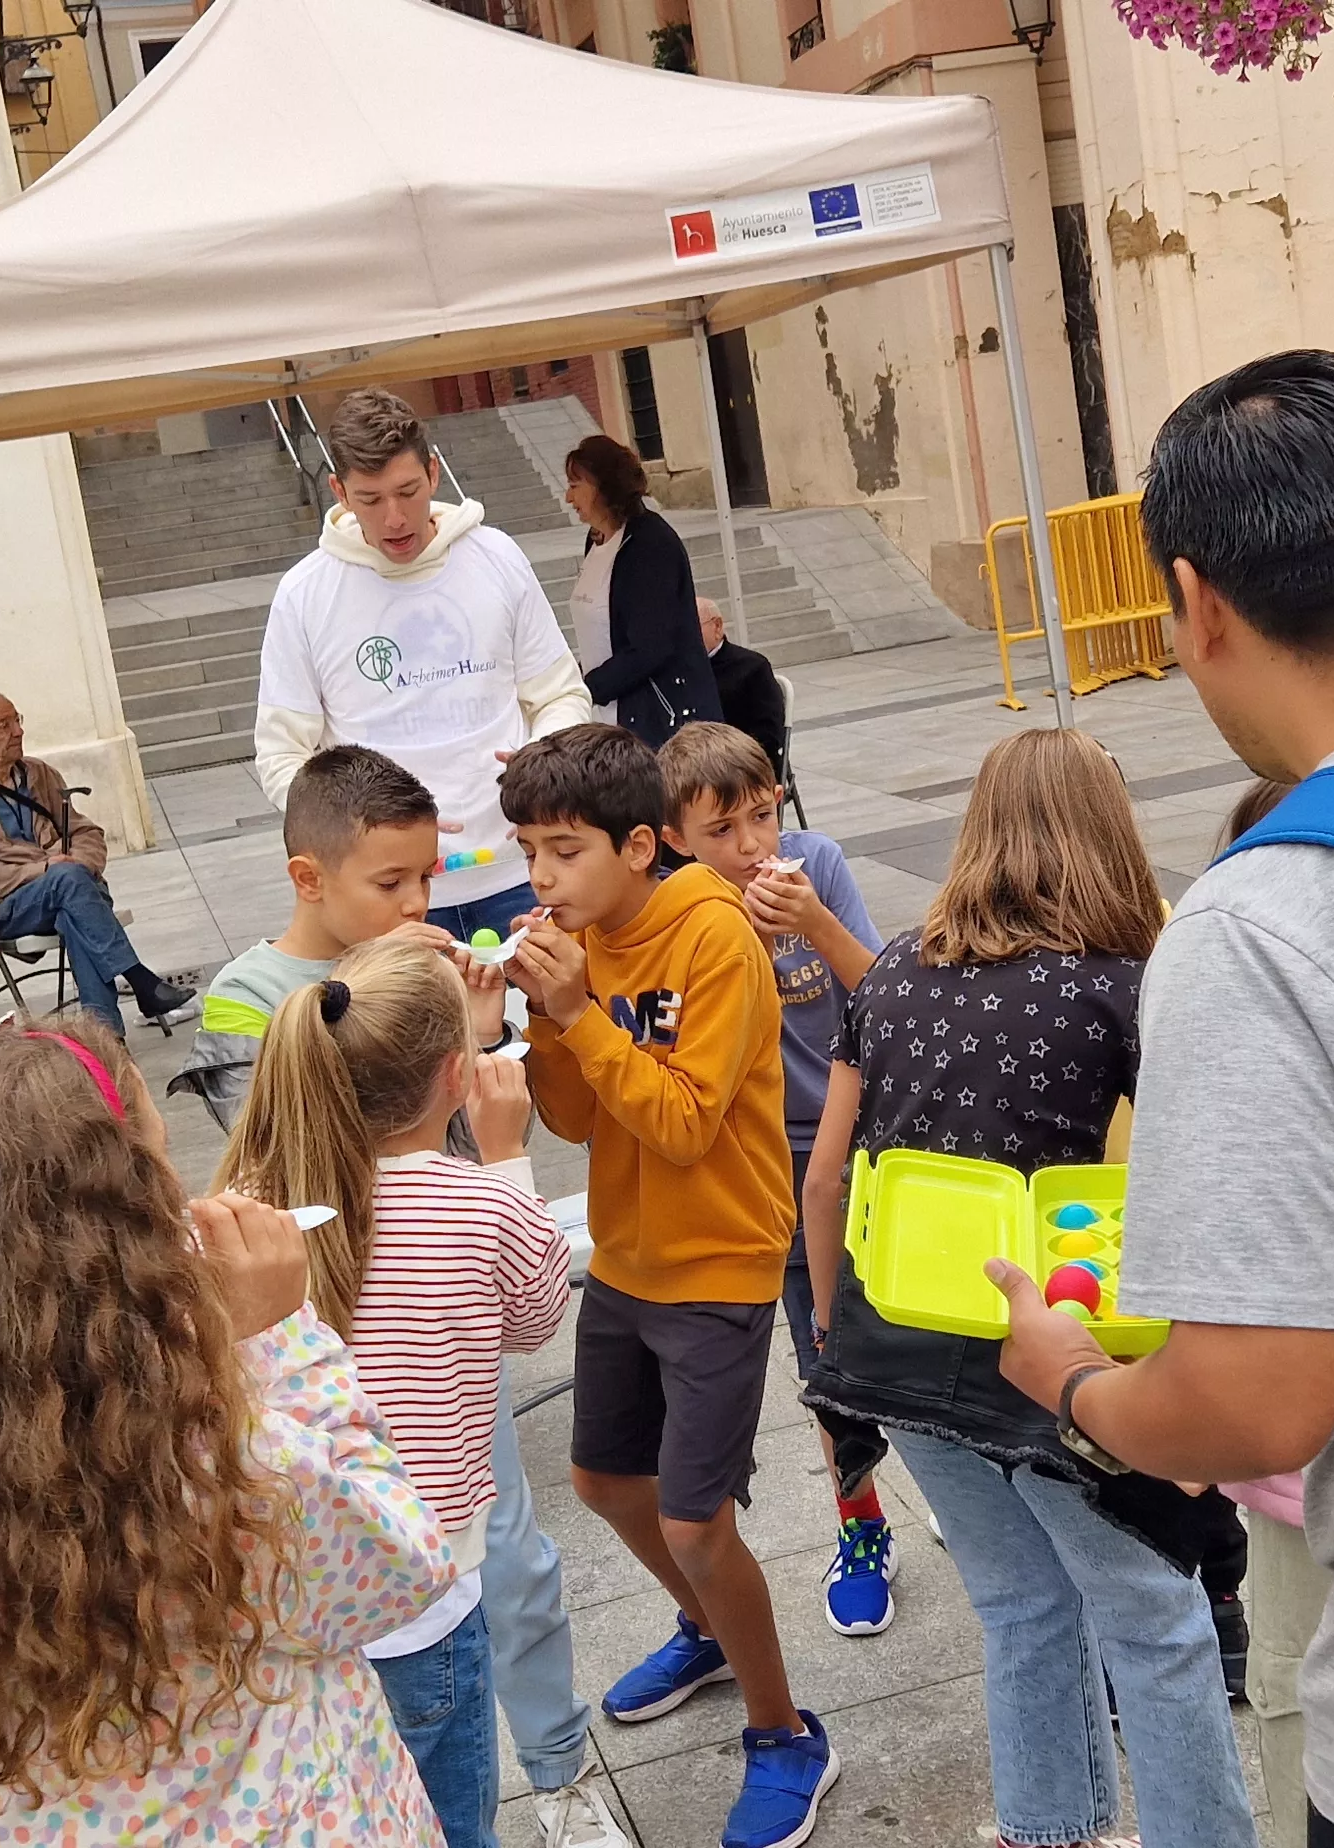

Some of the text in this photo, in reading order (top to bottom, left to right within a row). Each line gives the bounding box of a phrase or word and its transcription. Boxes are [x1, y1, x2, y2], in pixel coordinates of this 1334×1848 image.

[722, 206, 804, 231] Ayuntamiento
[724, 223, 787, 244] de Huesca
[396, 665, 458, 689] Alzheimer
